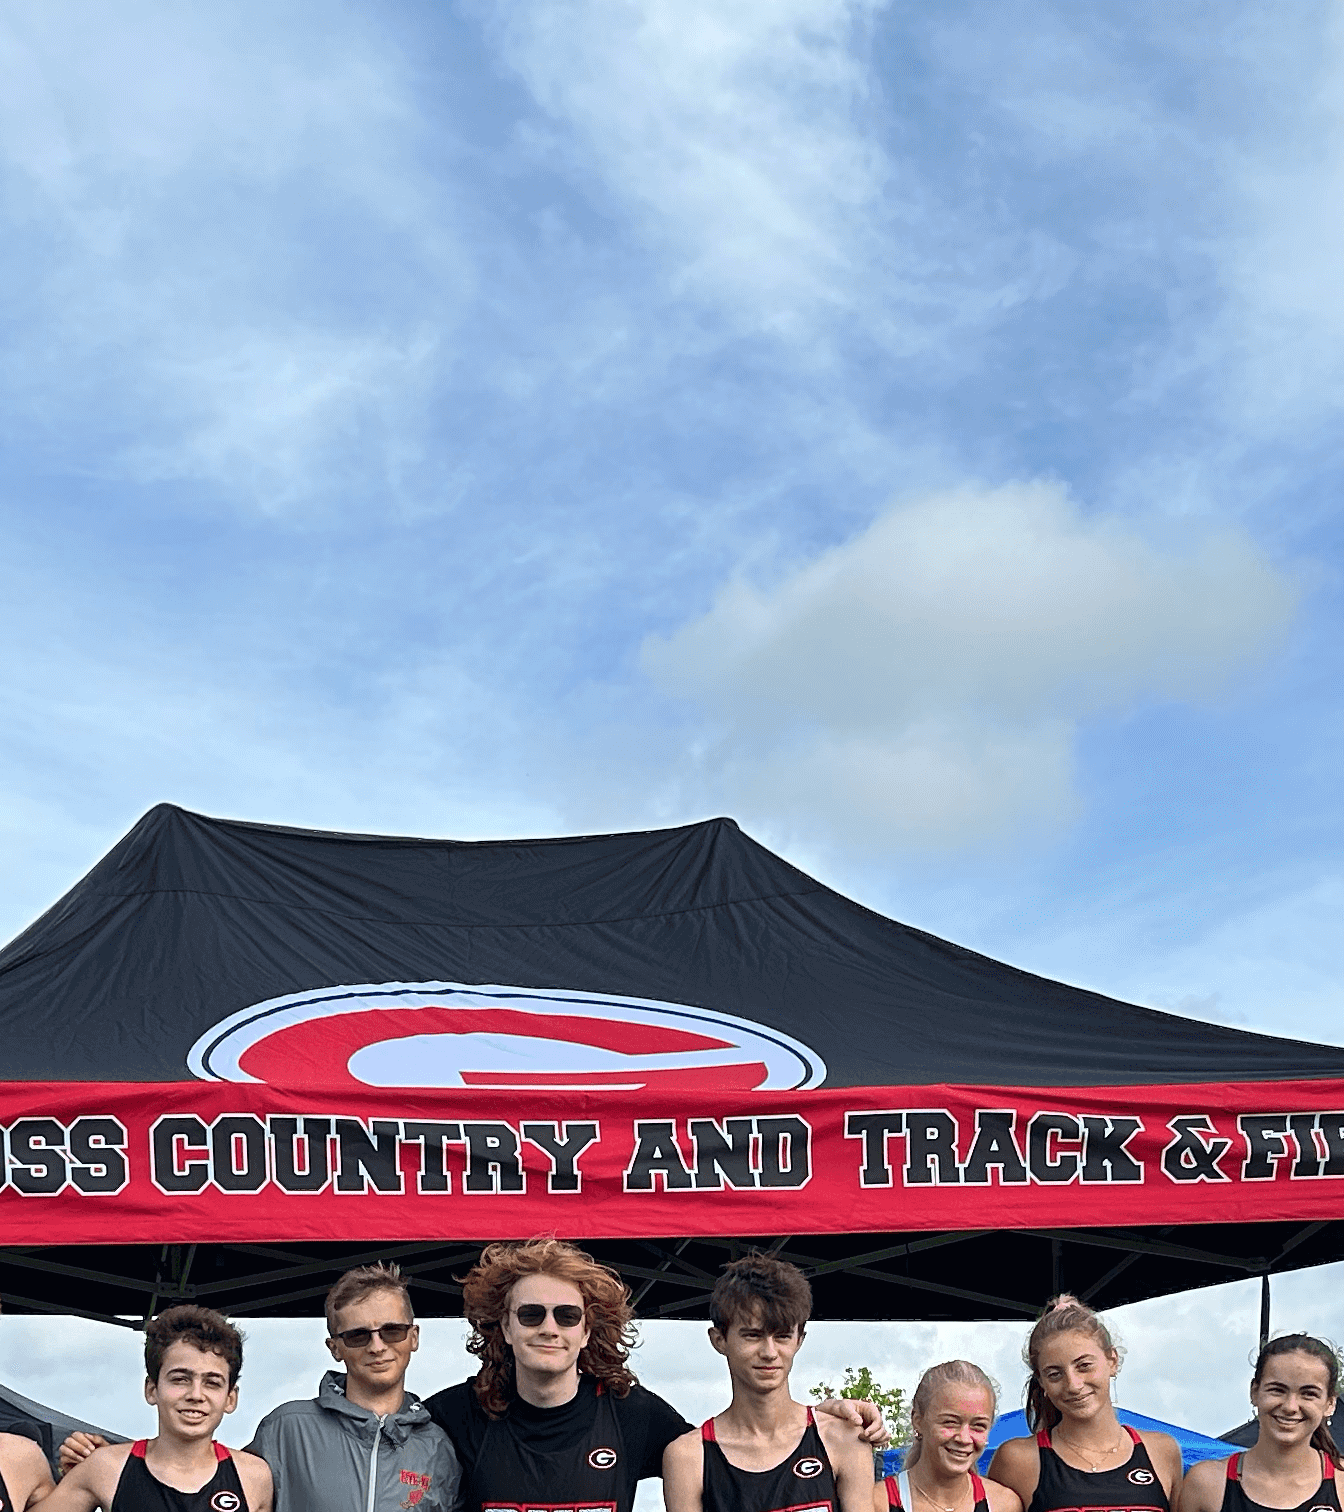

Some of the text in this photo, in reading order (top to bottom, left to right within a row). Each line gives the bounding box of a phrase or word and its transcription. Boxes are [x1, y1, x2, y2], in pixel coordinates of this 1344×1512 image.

[148, 1113, 600, 1195] COUNTRY
[623, 1114, 813, 1193] AND
[845, 1109, 1145, 1188] TRACK
[1161, 1115, 1232, 1183] &
